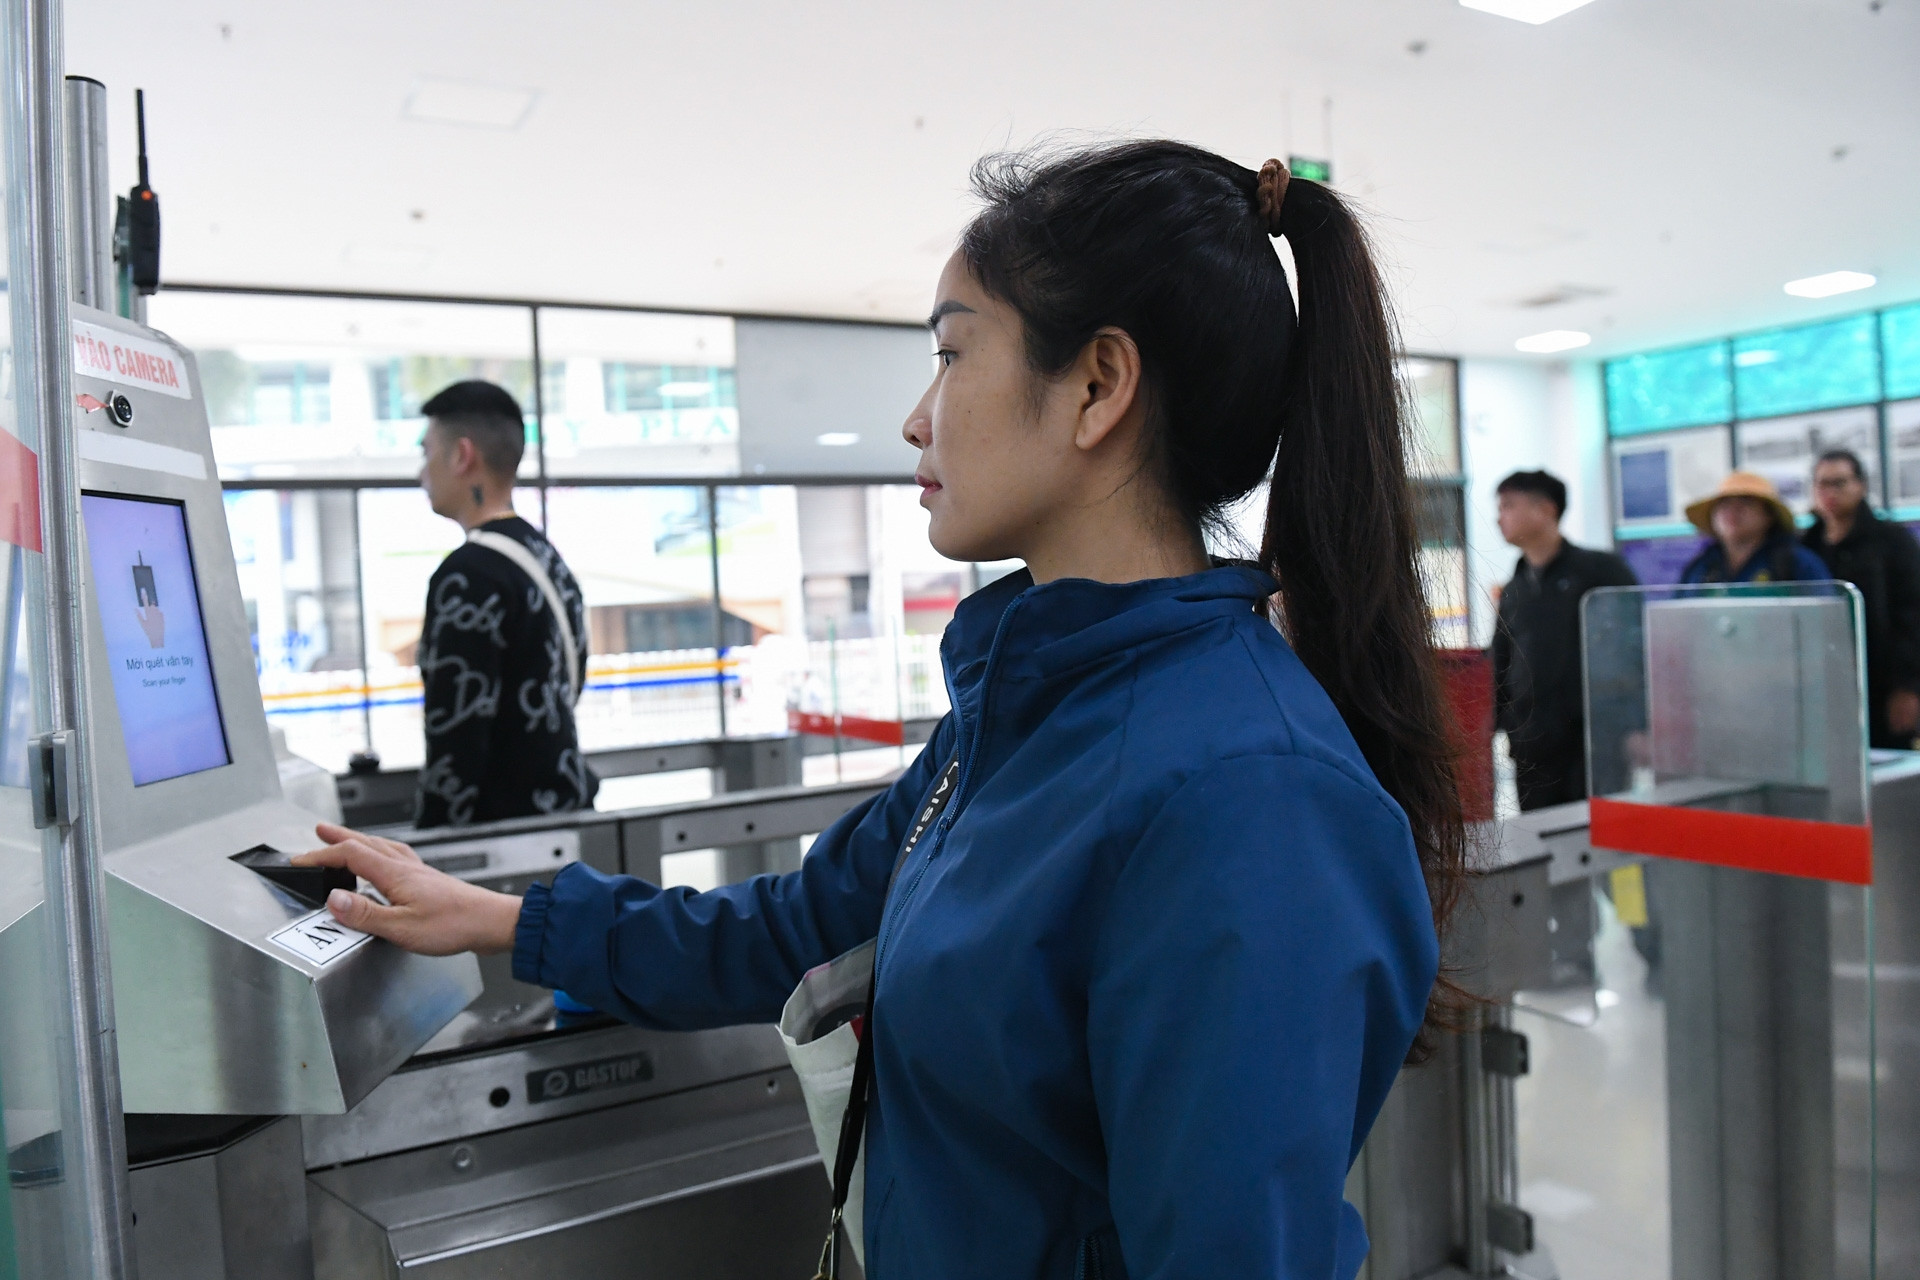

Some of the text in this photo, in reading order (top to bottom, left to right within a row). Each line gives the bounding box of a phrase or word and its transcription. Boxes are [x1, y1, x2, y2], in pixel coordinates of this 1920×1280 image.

[75, 330, 180, 389] VÀO CAMERA
[181, 656, 193, 667] tay
[142, 678, 158, 688] Scan
[159, 678, 170, 687] your
[905, 760, 960, 853] LAISHI
